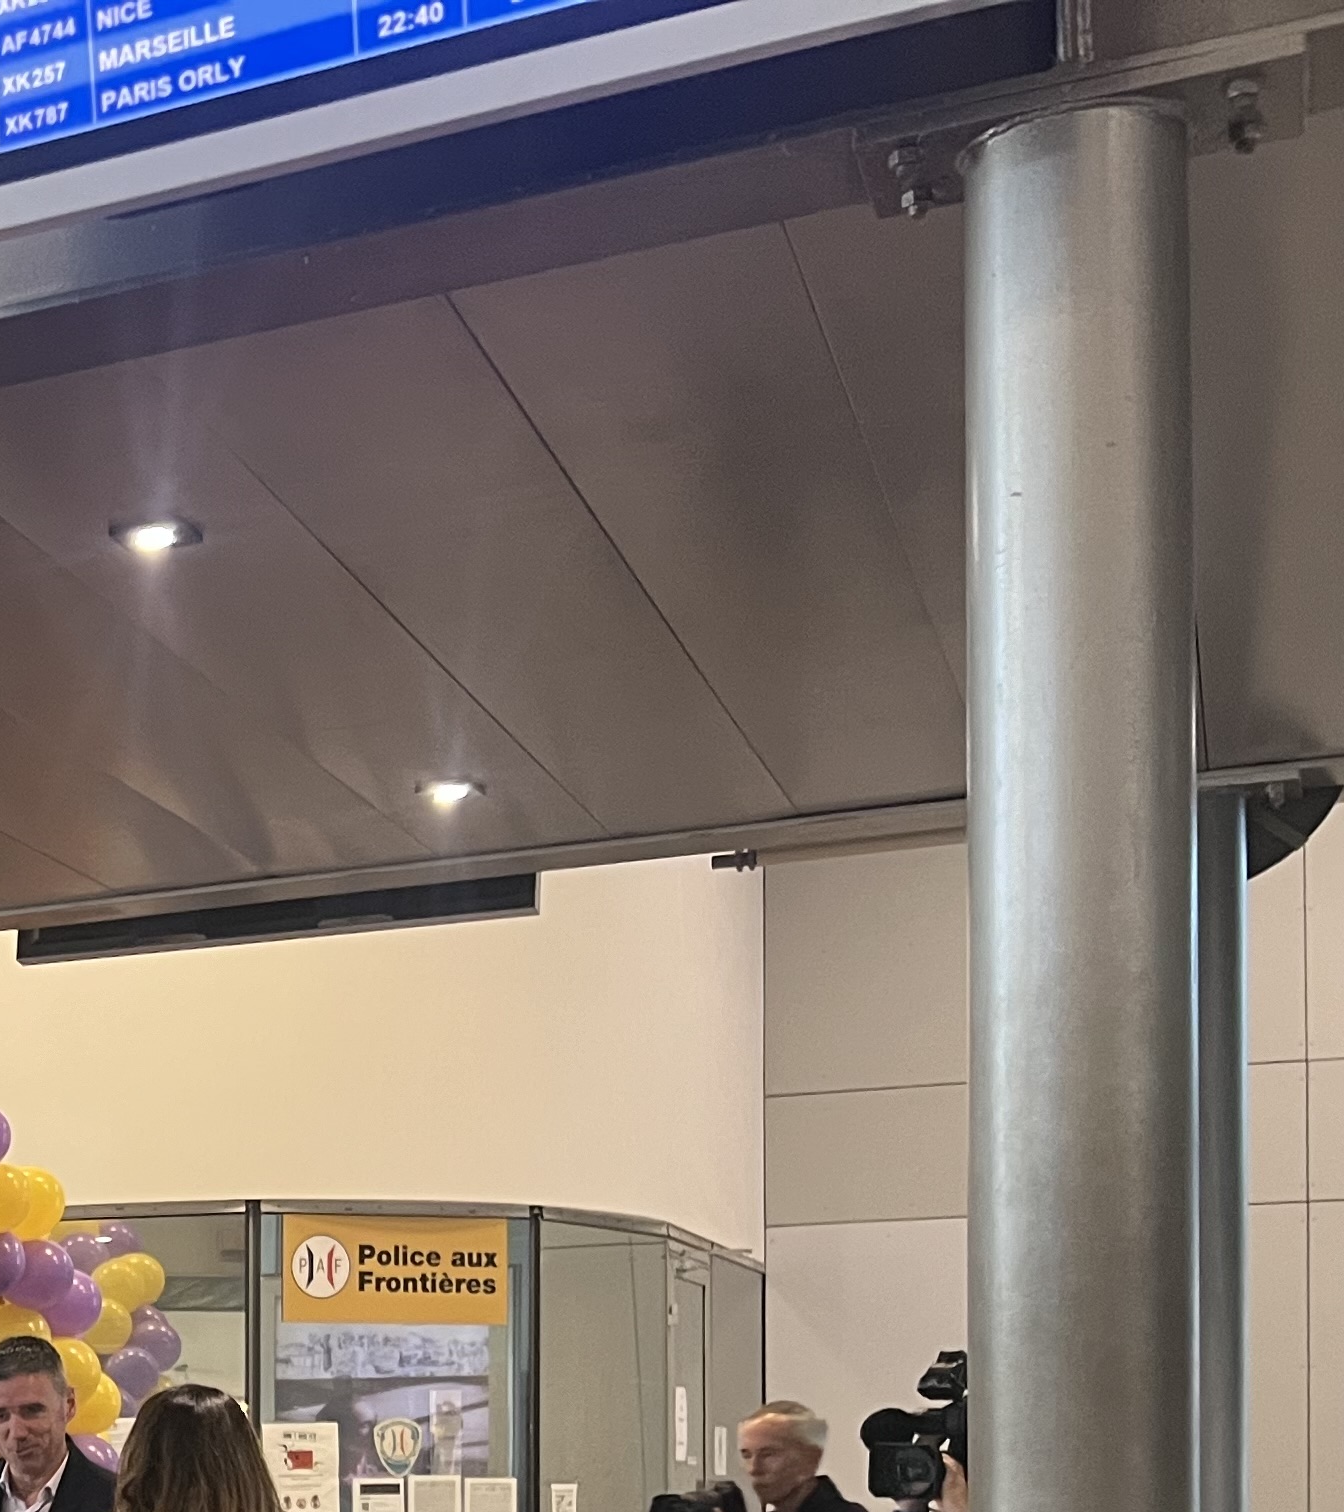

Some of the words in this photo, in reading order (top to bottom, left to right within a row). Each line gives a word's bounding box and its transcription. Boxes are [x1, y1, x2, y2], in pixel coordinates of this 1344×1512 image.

[97, 0, 153, 31] NICE
[377, 1, 444, 38] 22:40
[1, 16, 76, 56] AF4744
[99, 15, 236, 72] MARSEILLE
[101, 75, 173, 113] PARIS
[179, 56, 246, 93] ORLY
[358, 1244, 441, 1267] Police
[450, 1250, 497, 1268] aux
[358, 1270, 496, 1294] Frontières
